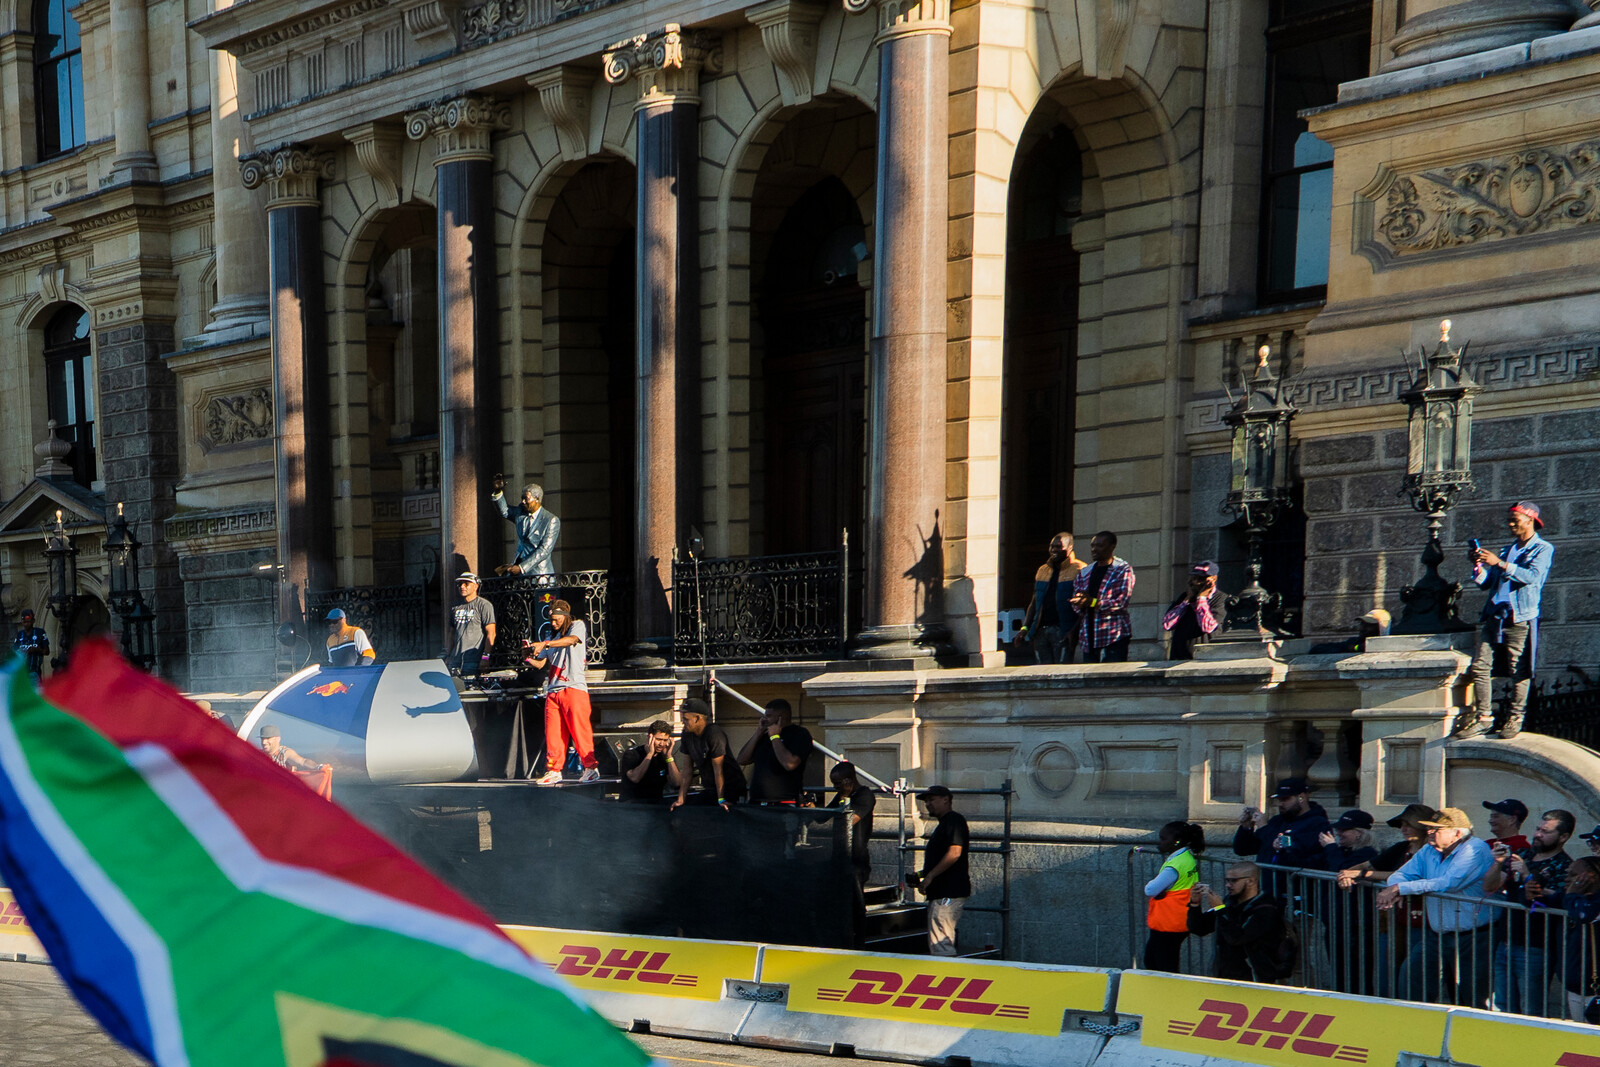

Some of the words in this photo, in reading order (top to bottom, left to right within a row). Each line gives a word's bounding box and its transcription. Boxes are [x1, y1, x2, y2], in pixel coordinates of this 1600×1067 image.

[555, 945, 675, 984] DHL
[843, 969, 1000, 1015] DHL
[1191, 999, 1340, 1058] DHL
